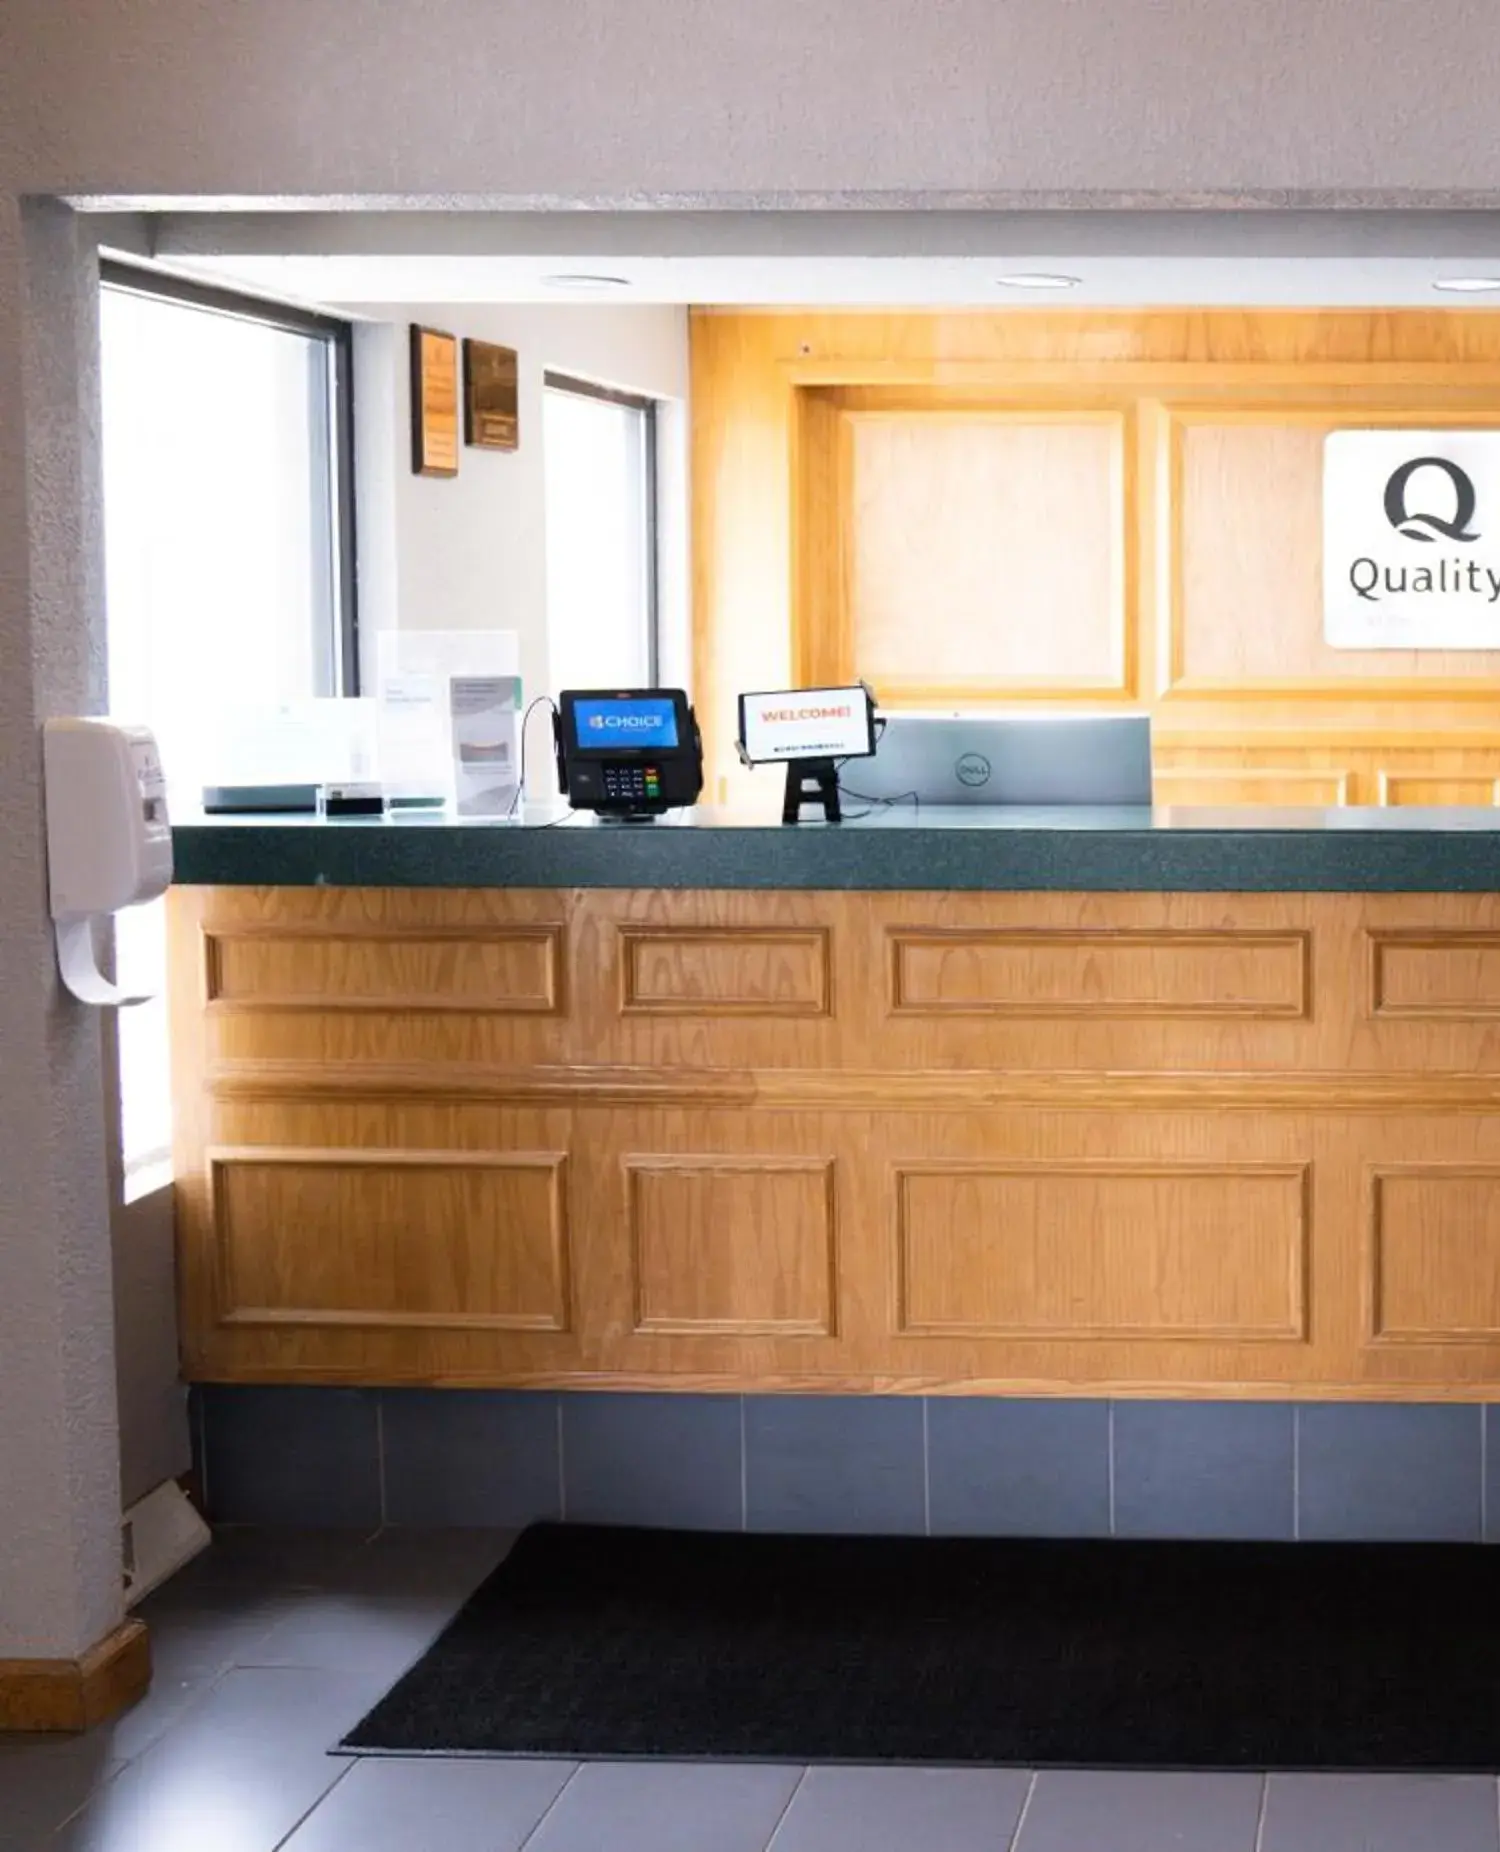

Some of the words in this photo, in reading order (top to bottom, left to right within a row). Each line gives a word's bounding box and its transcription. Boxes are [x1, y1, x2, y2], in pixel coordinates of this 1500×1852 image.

[1383, 456, 1481, 542] Q
[605, 715, 663, 728] CHOICE
[761, 705, 851, 722] WELCOME!
